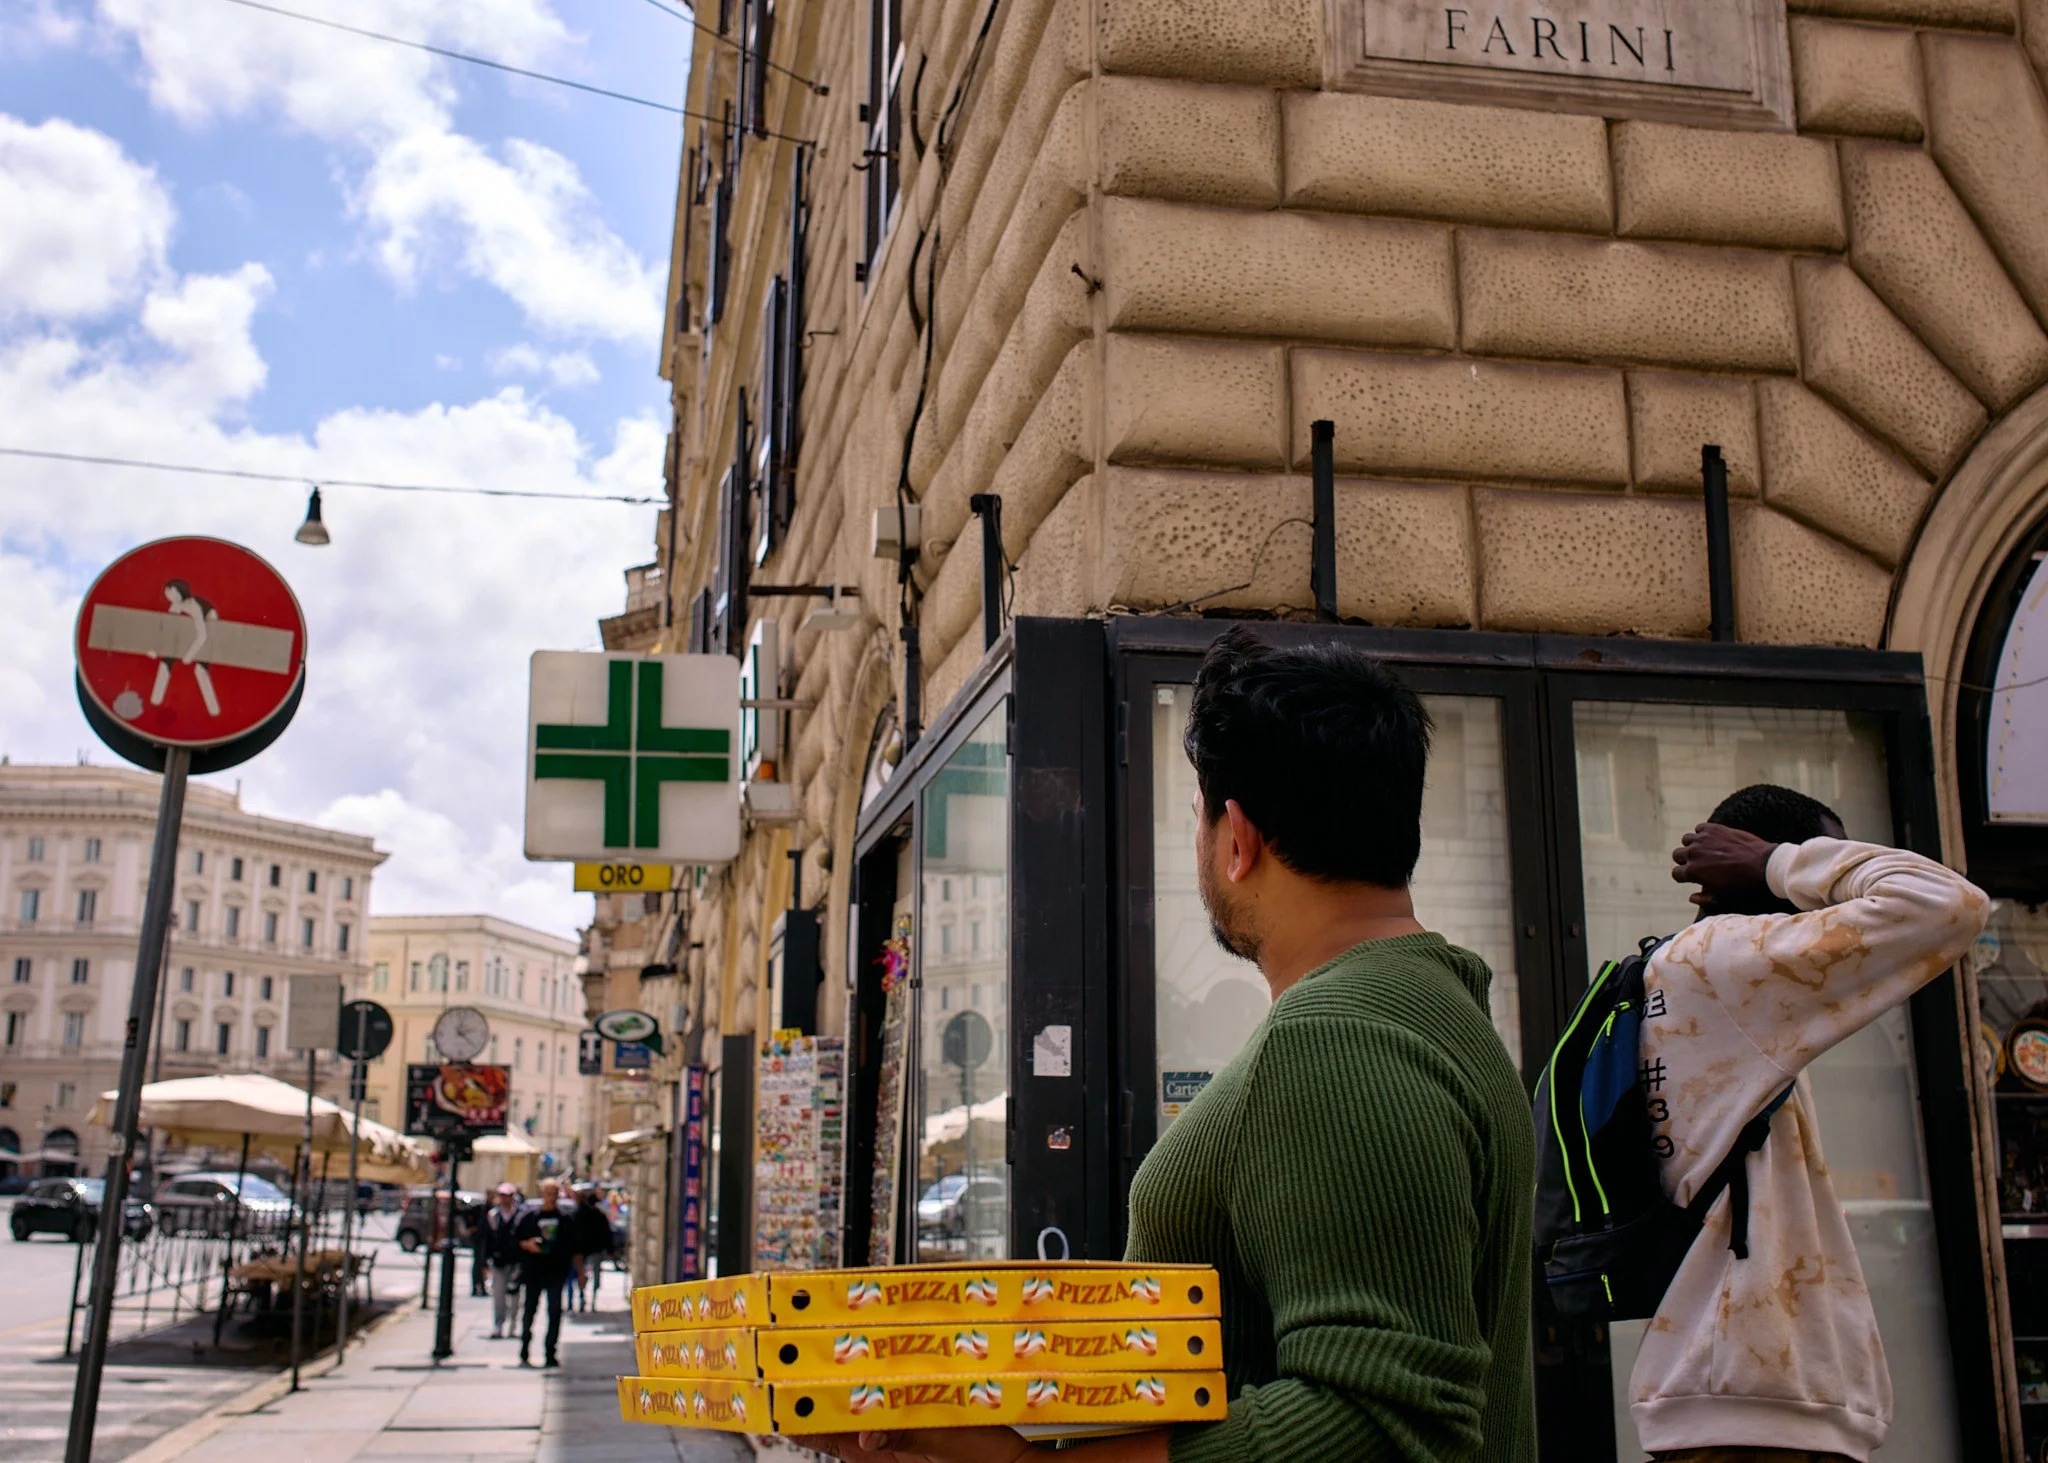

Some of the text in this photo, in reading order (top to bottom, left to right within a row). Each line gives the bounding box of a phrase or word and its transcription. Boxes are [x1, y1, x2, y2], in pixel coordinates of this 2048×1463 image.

[1444, 8, 1676, 72] FARINI
[599, 864, 645, 886] ORO
[884, 1280, 1131, 1307] PIZZA PIZZA
[661, 1296, 737, 1321] PIZZA PIZZA
[872, 1333, 1125, 1360] PIZZA PIZZA
[651, 1391, 736, 1422] PIZZA PIZZA
[887, 1382, 1136, 1410] PIZZA PIZZA
